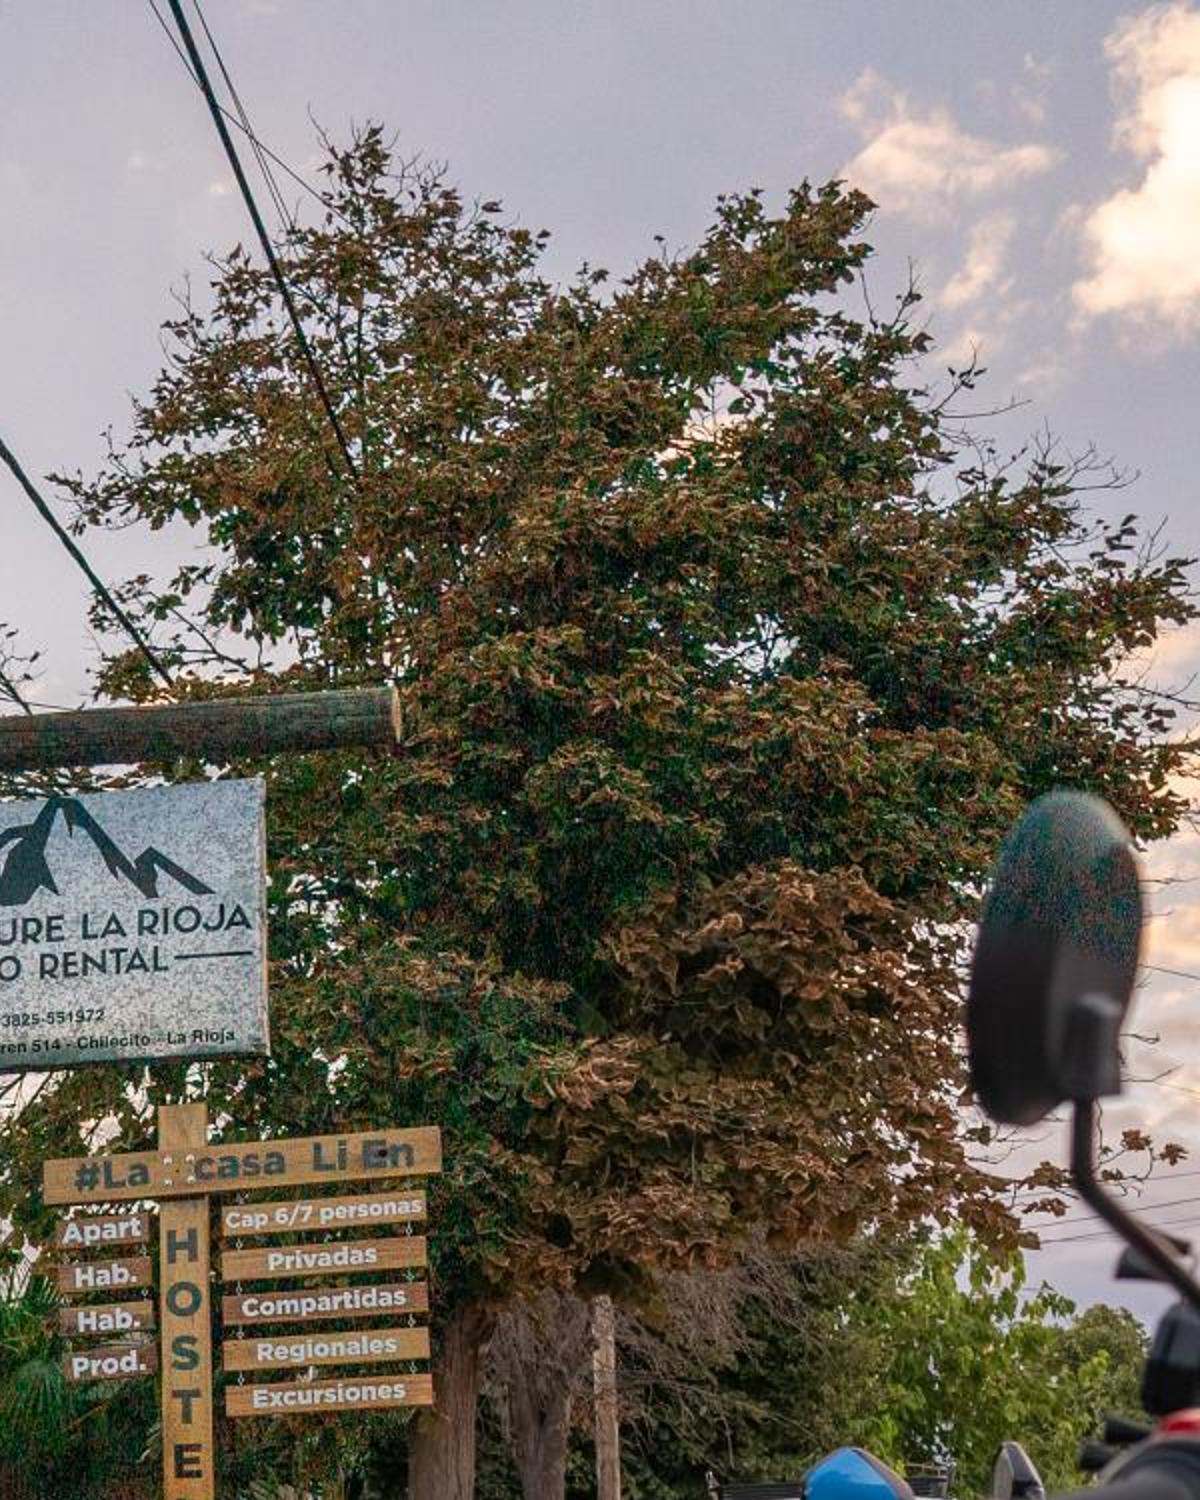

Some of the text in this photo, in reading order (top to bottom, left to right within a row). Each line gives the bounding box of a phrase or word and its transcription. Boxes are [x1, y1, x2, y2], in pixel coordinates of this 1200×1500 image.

[81, 911, 127, 940] LA
[138, 904, 253, 936] RIOJA
[38, 946, 170, 981] RENTAL
[31, 1039, 60, 1053] 514
[77, 1033, 150, 1050] Chilecito
[167, 1031, 187, 1045] La
[192, 1027, 235, 1045] Rioja
[75, 1160, 150, 1192] #La
[195, 1151, 286, 1181] casa
[225, 1196, 423, 1234] Cap 6/7 personas
[62, 1216, 143, 1246] Apart
[267, 1245, 378, 1272] Privadas
[74, 1262, 138, 1289] Hab.
[241, 1288, 407, 1319] Compartidas
[77, 1308, 141, 1333] Hab.
[72, 1351, 148, 1379] Prod.
[256, 1337, 399, 1365] Regionales
[252, 1381, 406, 1409] Excursiones
